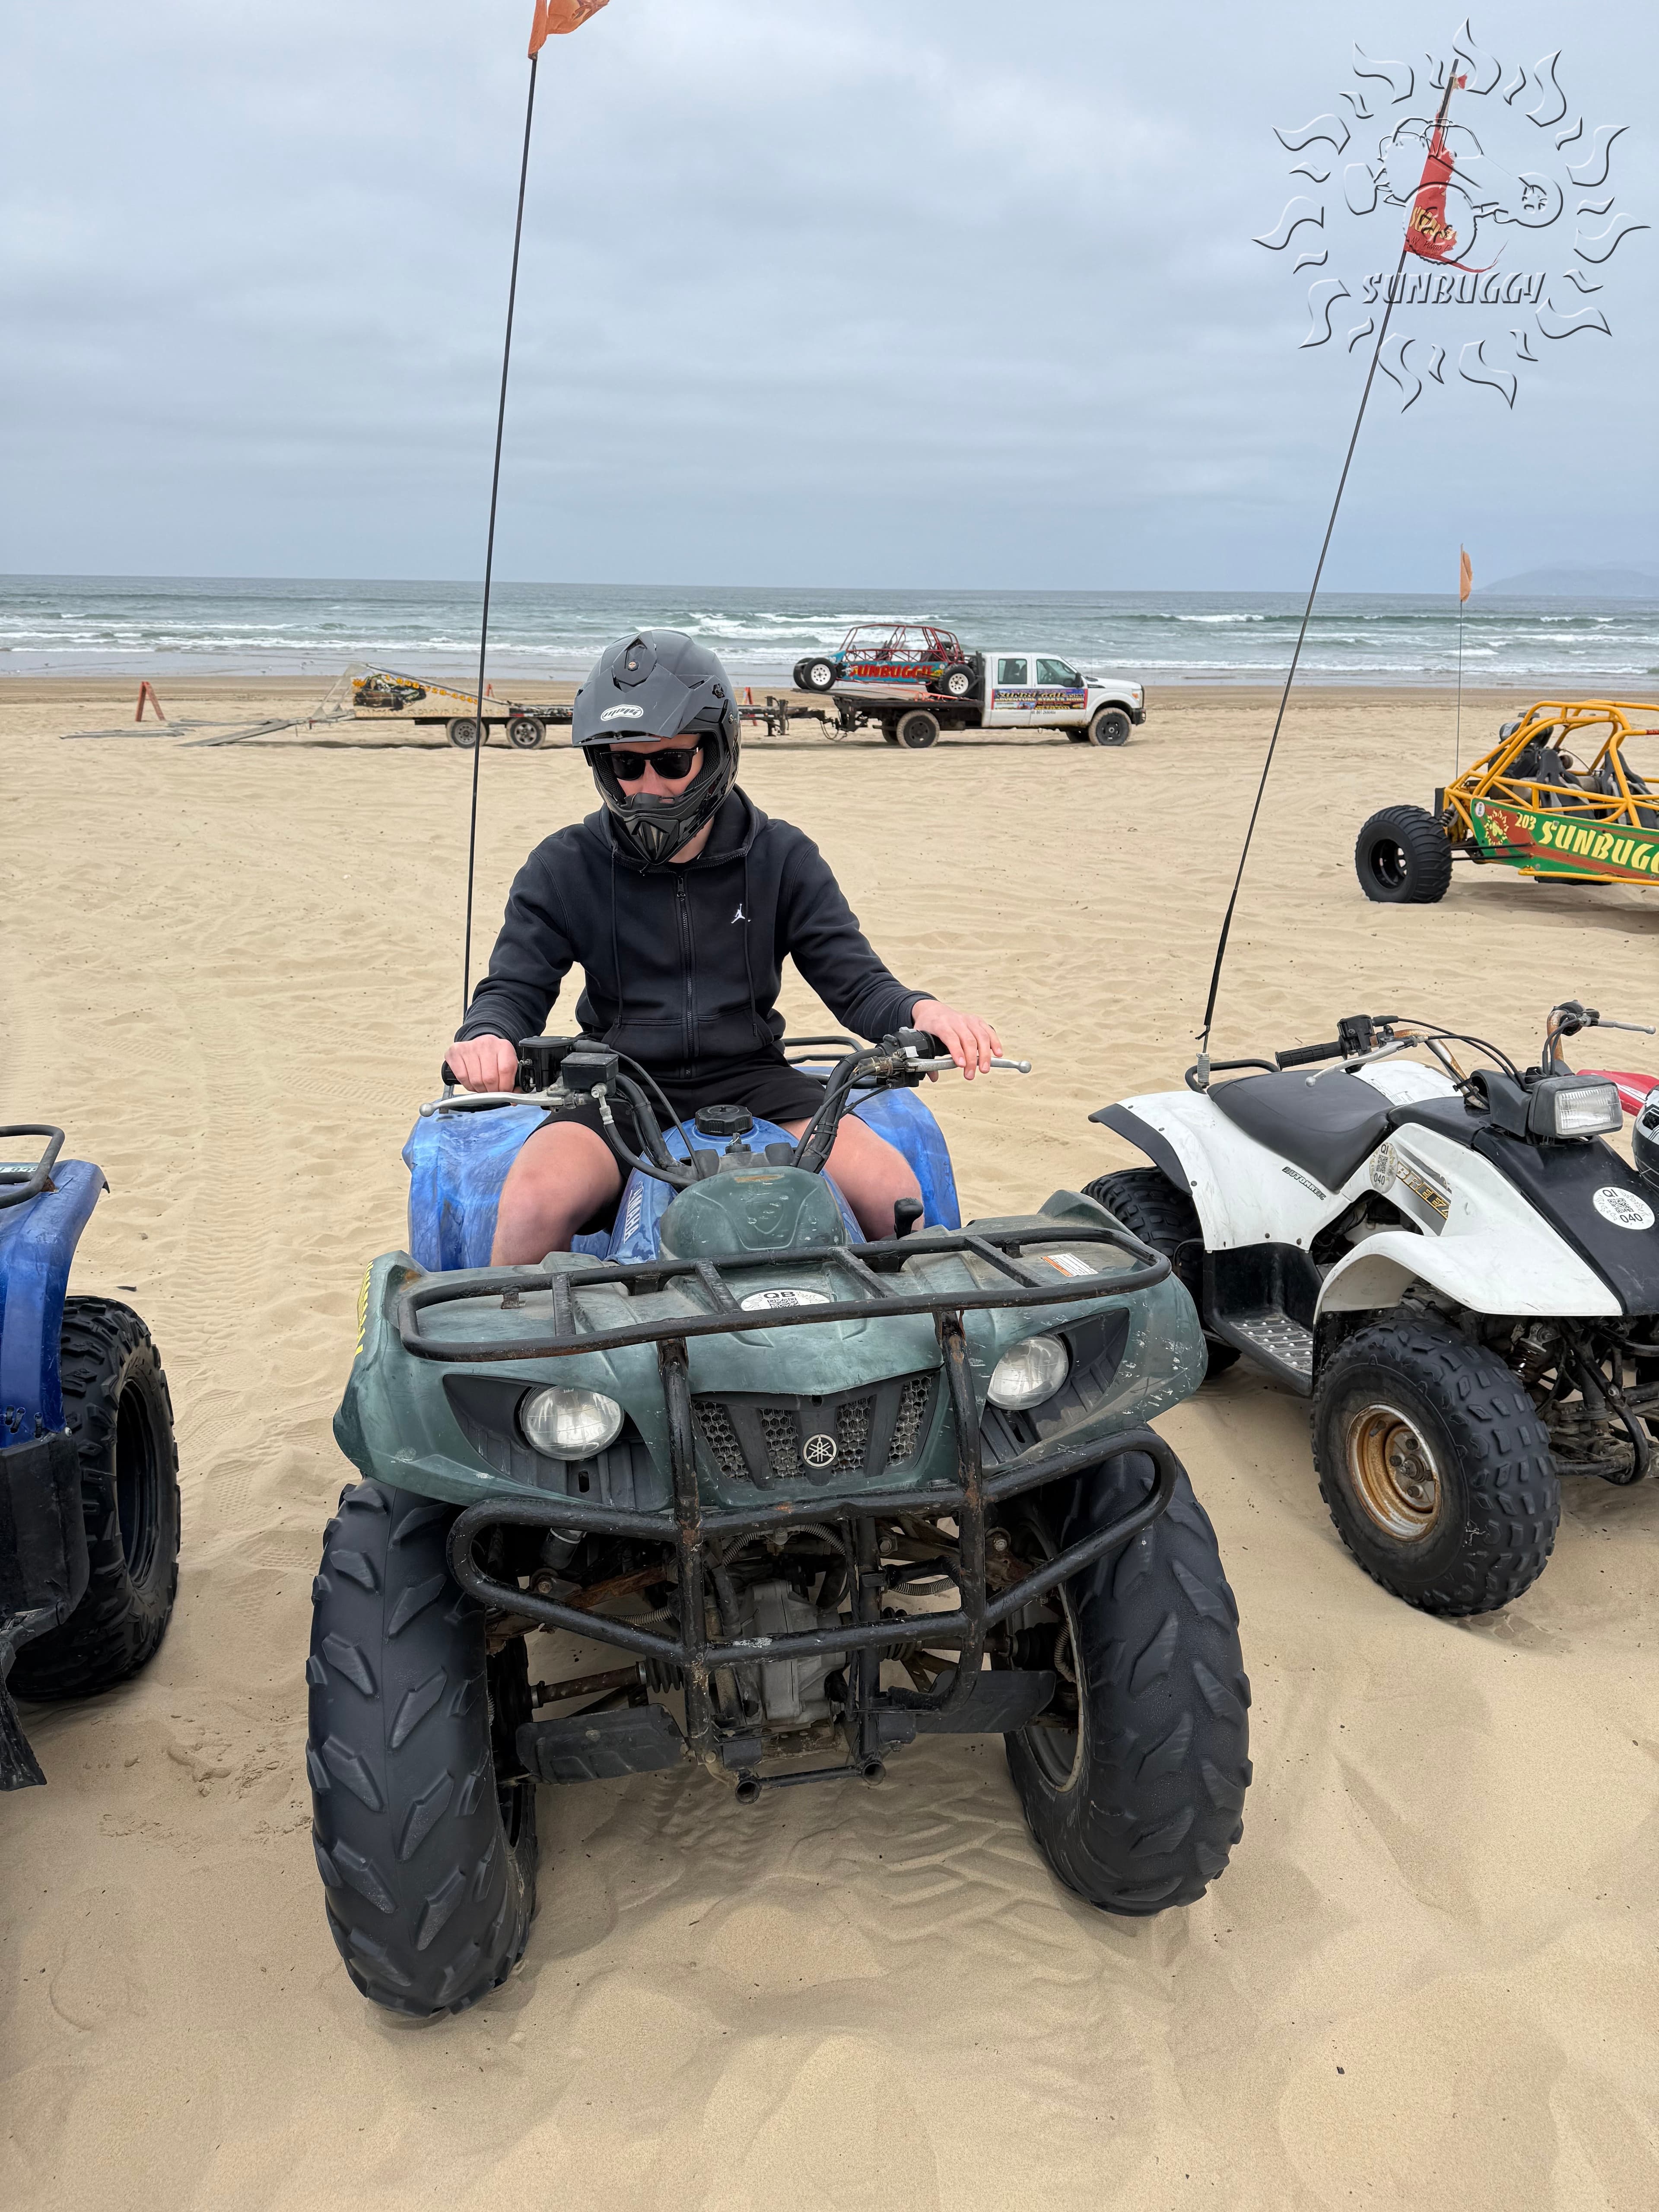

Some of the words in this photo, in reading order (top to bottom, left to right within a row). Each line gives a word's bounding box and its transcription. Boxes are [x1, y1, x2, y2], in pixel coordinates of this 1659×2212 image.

[1515, 812, 1537, 830] 203
[1282, 1166, 1326, 1200] AUTOMATIC
[1374, 1173, 1385, 1185] 040
[1397, 1161, 1449, 1219] BREEZ
[624, 1181, 643, 1244] MAHA
[1620, 1213, 1643, 1223] 040
